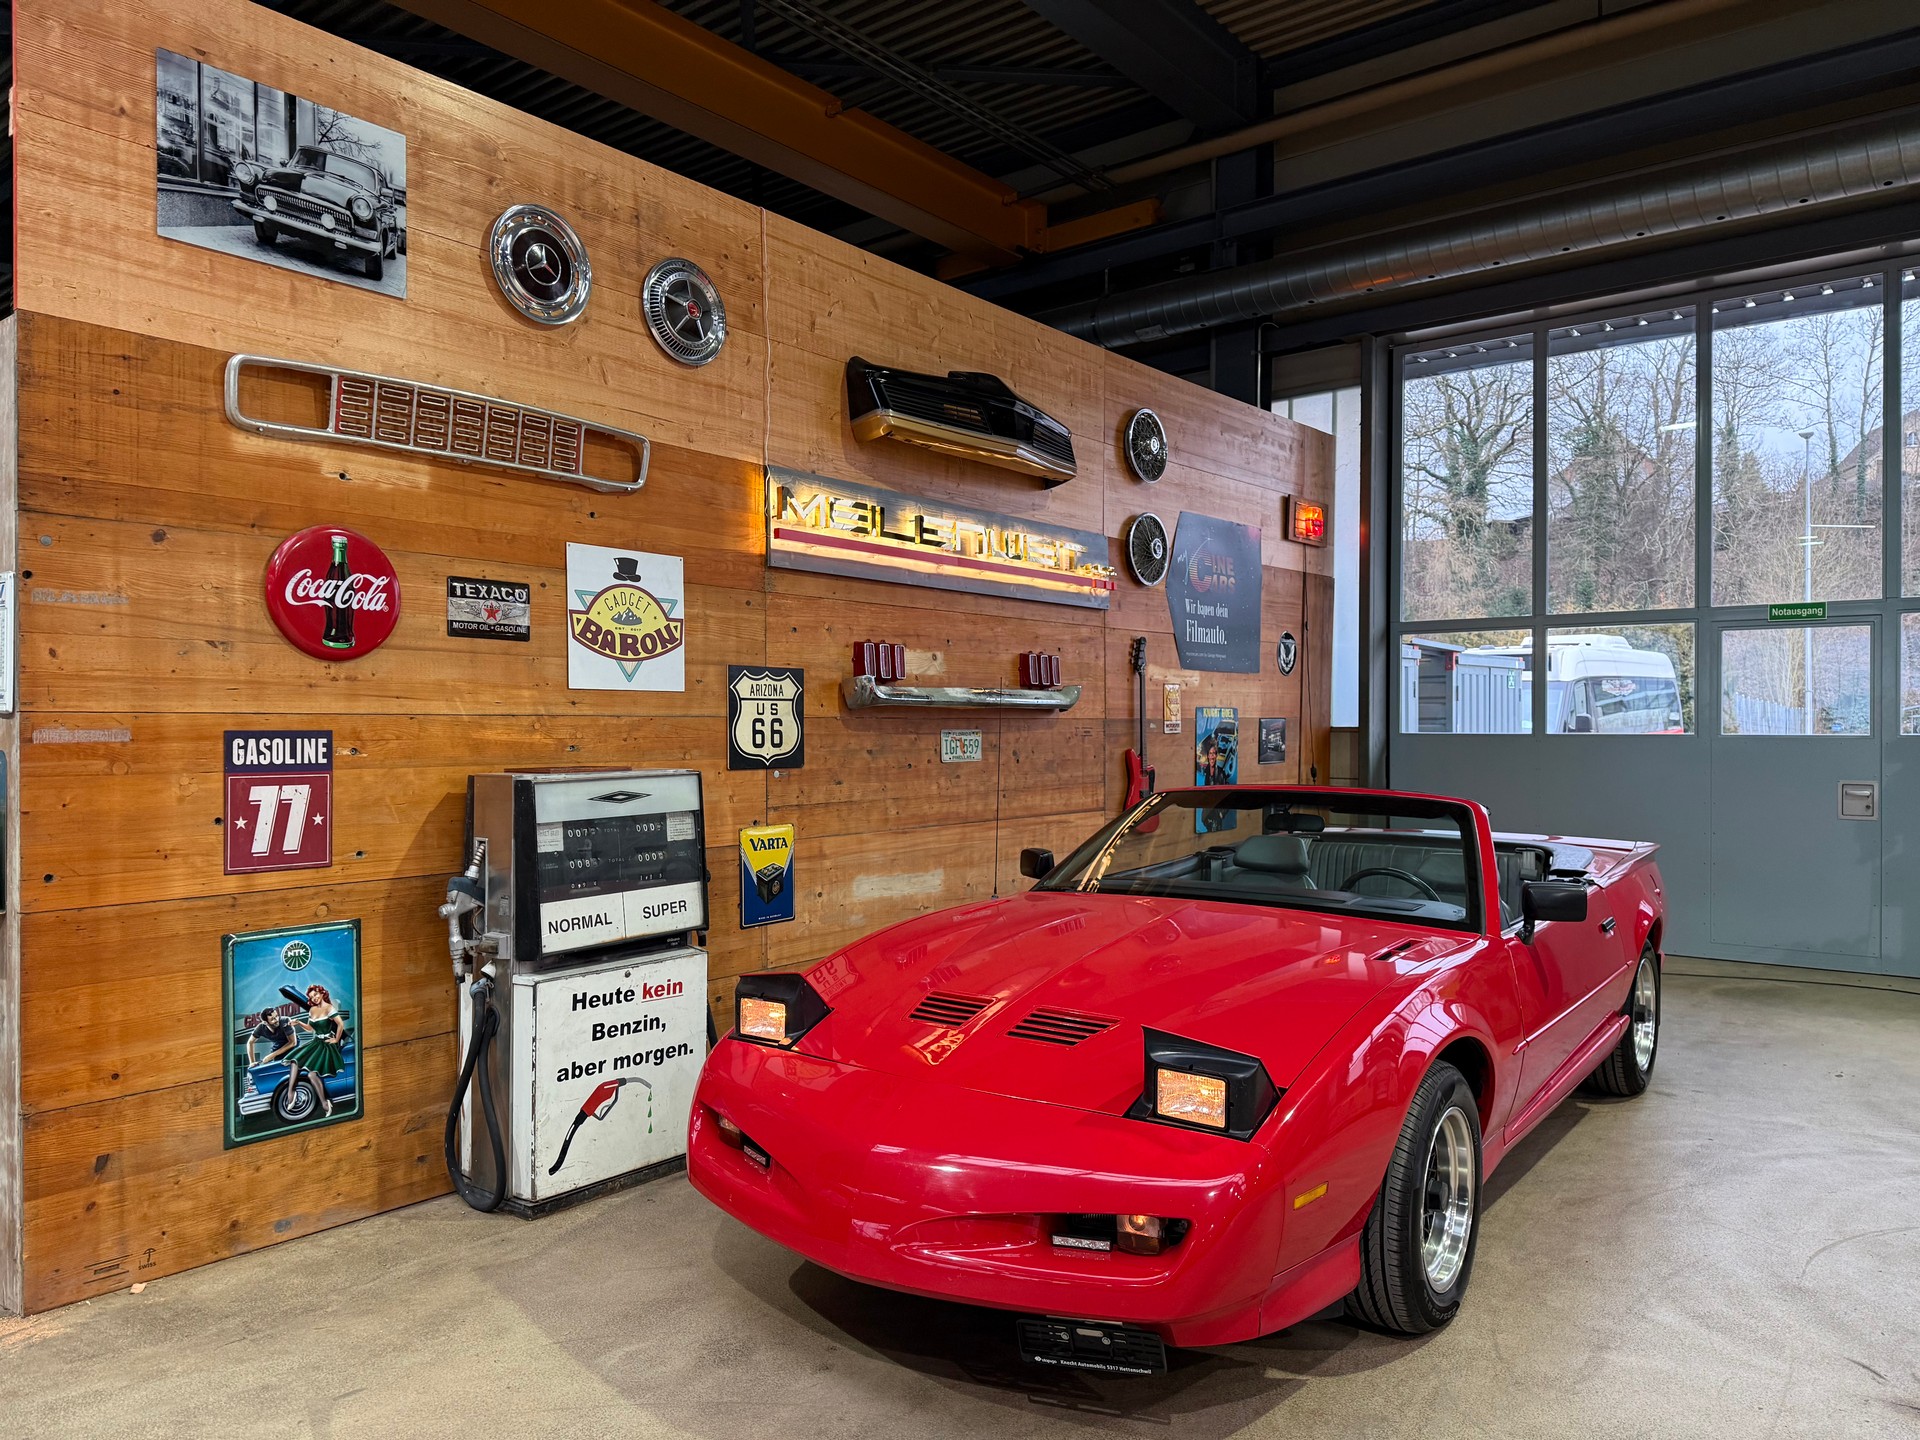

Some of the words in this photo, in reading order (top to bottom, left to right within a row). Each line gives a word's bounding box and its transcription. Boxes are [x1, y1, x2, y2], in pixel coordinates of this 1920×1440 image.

[285, 568, 390, 611] Coca-Cola
[451, 582, 528, 602] TEXACO
[604, 591, 652, 614] GADGET
[1185, 598, 1196, 614] Wir
[1215, 603, 1228, 618] dein
[1772, 607, 1823, 617] Notausgang
[452, 622, 478, 630] MOTOR
[494, 625, 527, 634] GASOLINE
[576, 616, 679, 657] BARON
[1186, 619, 1227, 645] Filmauto.
[749, 683, 784, 697] ARIZONA
[751, 717, 783, 749] 66
[232, 738, 328, 766] GASOLINE
[749, 837, 788, 852] VARTA
[642, 899, 688, 919] SUPER
[548, 912, 613, 935] NORMAL
[287, 948, 306, 958] NTK
[572, 986, 636, 1012] Heute
[641, 979, 684, 1001] kein
[591, 1014, 667, 1042] Benzin,
[556, 1059, 607, 1083] aber
[613, 1042, 694, 1071] morgen.
